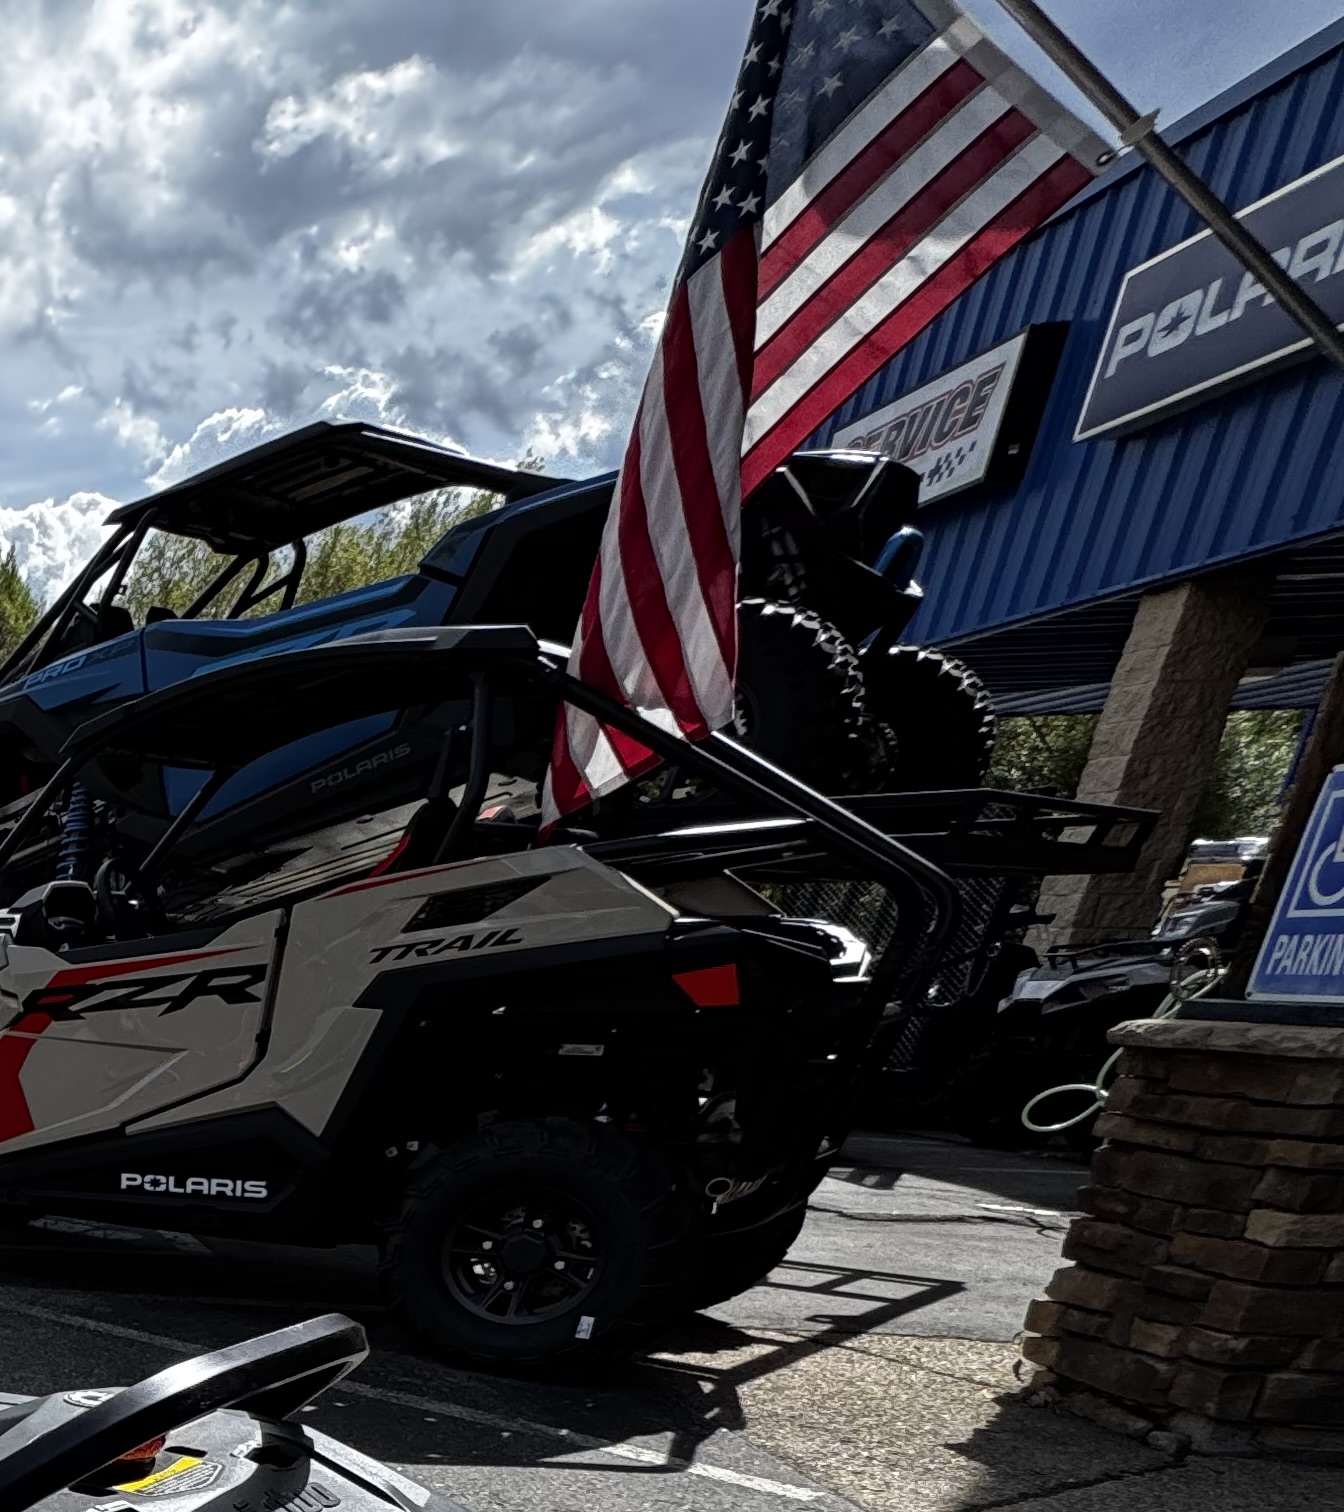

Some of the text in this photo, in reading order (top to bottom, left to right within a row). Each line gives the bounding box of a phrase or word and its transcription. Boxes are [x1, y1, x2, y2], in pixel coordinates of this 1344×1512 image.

[23, 655, 88, 690] PRO
[311, 742, 411, 793] POLARIS
[369, 928, 523, 964] TRAIL
[6, 964, 268, 1030] RZR
[120, 1173, 268, 1198] POLARIS
